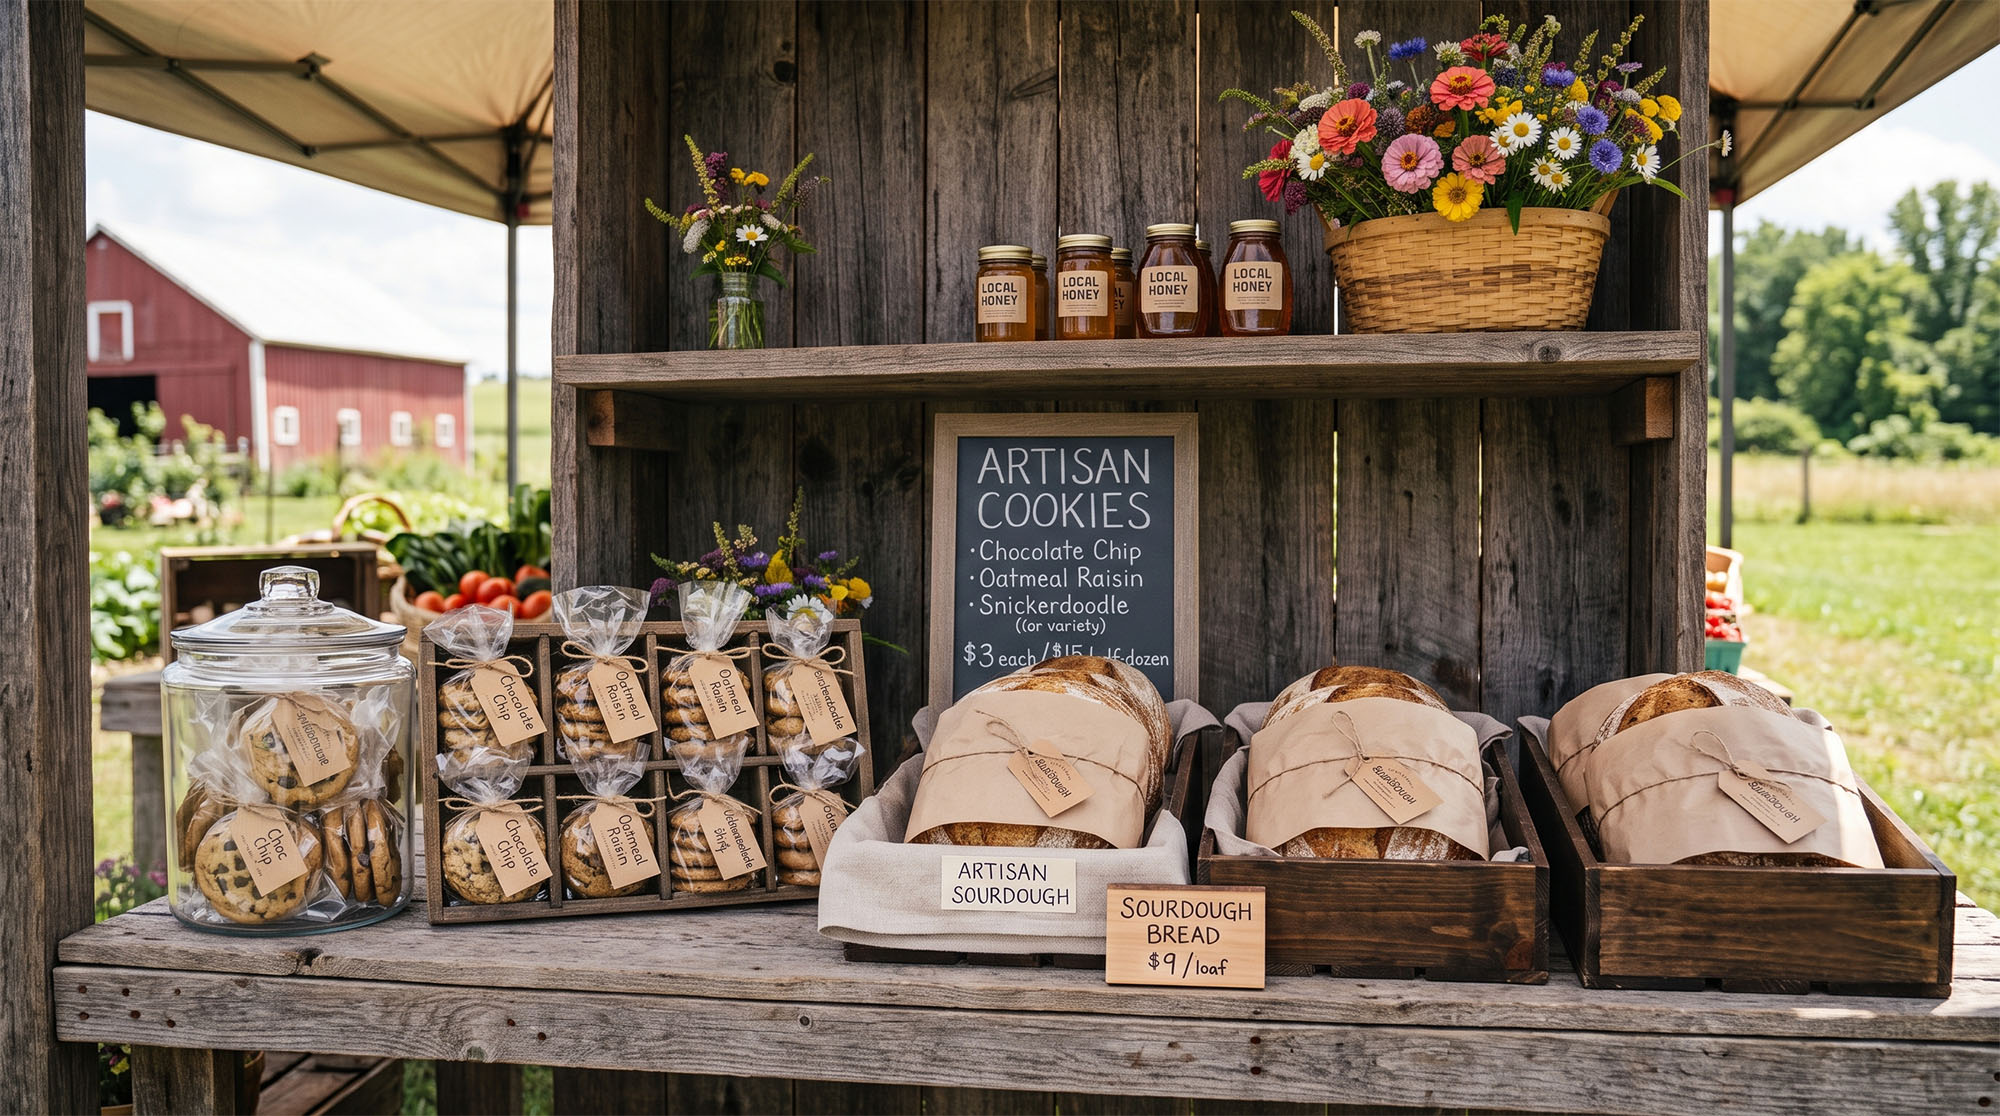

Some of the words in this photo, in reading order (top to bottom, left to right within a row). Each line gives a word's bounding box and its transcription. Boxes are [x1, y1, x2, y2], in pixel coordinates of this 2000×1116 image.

[1063, 276, 1100, 288] LOCAL
[1150, 271, 1188, 282] LOCAL
[1233, 281, 1272, 292] HONEY
[1234, 268, 1272, 279] LOCAL
[981, 295, 1018, 306] HONEY
[982, 282, 1018, 294] LOCAL
[1062, 289, 1100, 300] HONEY
[1149, 284, 1188, 296] HONEY
[977, 447, 1150, 484] ARTISAN
[977, 492, 1150, 530] COOKIES
[979, 539, 1084, 561] Chocolate
[1093, 539, 1142, 566] Chip
[979, 567, 1068, 588] Oatmeal
[1078, 566, 1143, 588] Raisin
[979, 594, 1129, 615] Snickerdoodle
[1047, 618, 1106, 636] variety)
[963, 641, 994, 668] $3
[998, 648, 1036, 667] each
[500, 675, 534, 731] Chocolate
[606, 684, 626, 721] Raisin
[616, 671, 646, 721] Oatmeal
[719, 669, 747, 716] Oatmeal
[493, 694, 511, 721] Chip
[254, 838, 272, 865] Chip
[268, 829, 288, 860] Choc
[505, 819, 539, 877] Chocolate
[608, 827, 628, 866] Raisin
[619, 814, 648, 866] Oatmeal
[497, 840, 516, 869] Chip
[958, 862, 1048, 882] ARTISAN
[951, 886, 1070, 907] SOURDOUGH
[1120, 897, 1252, 922] SOURDOUGH
[1147, 924, 1220, 945] BREAD
